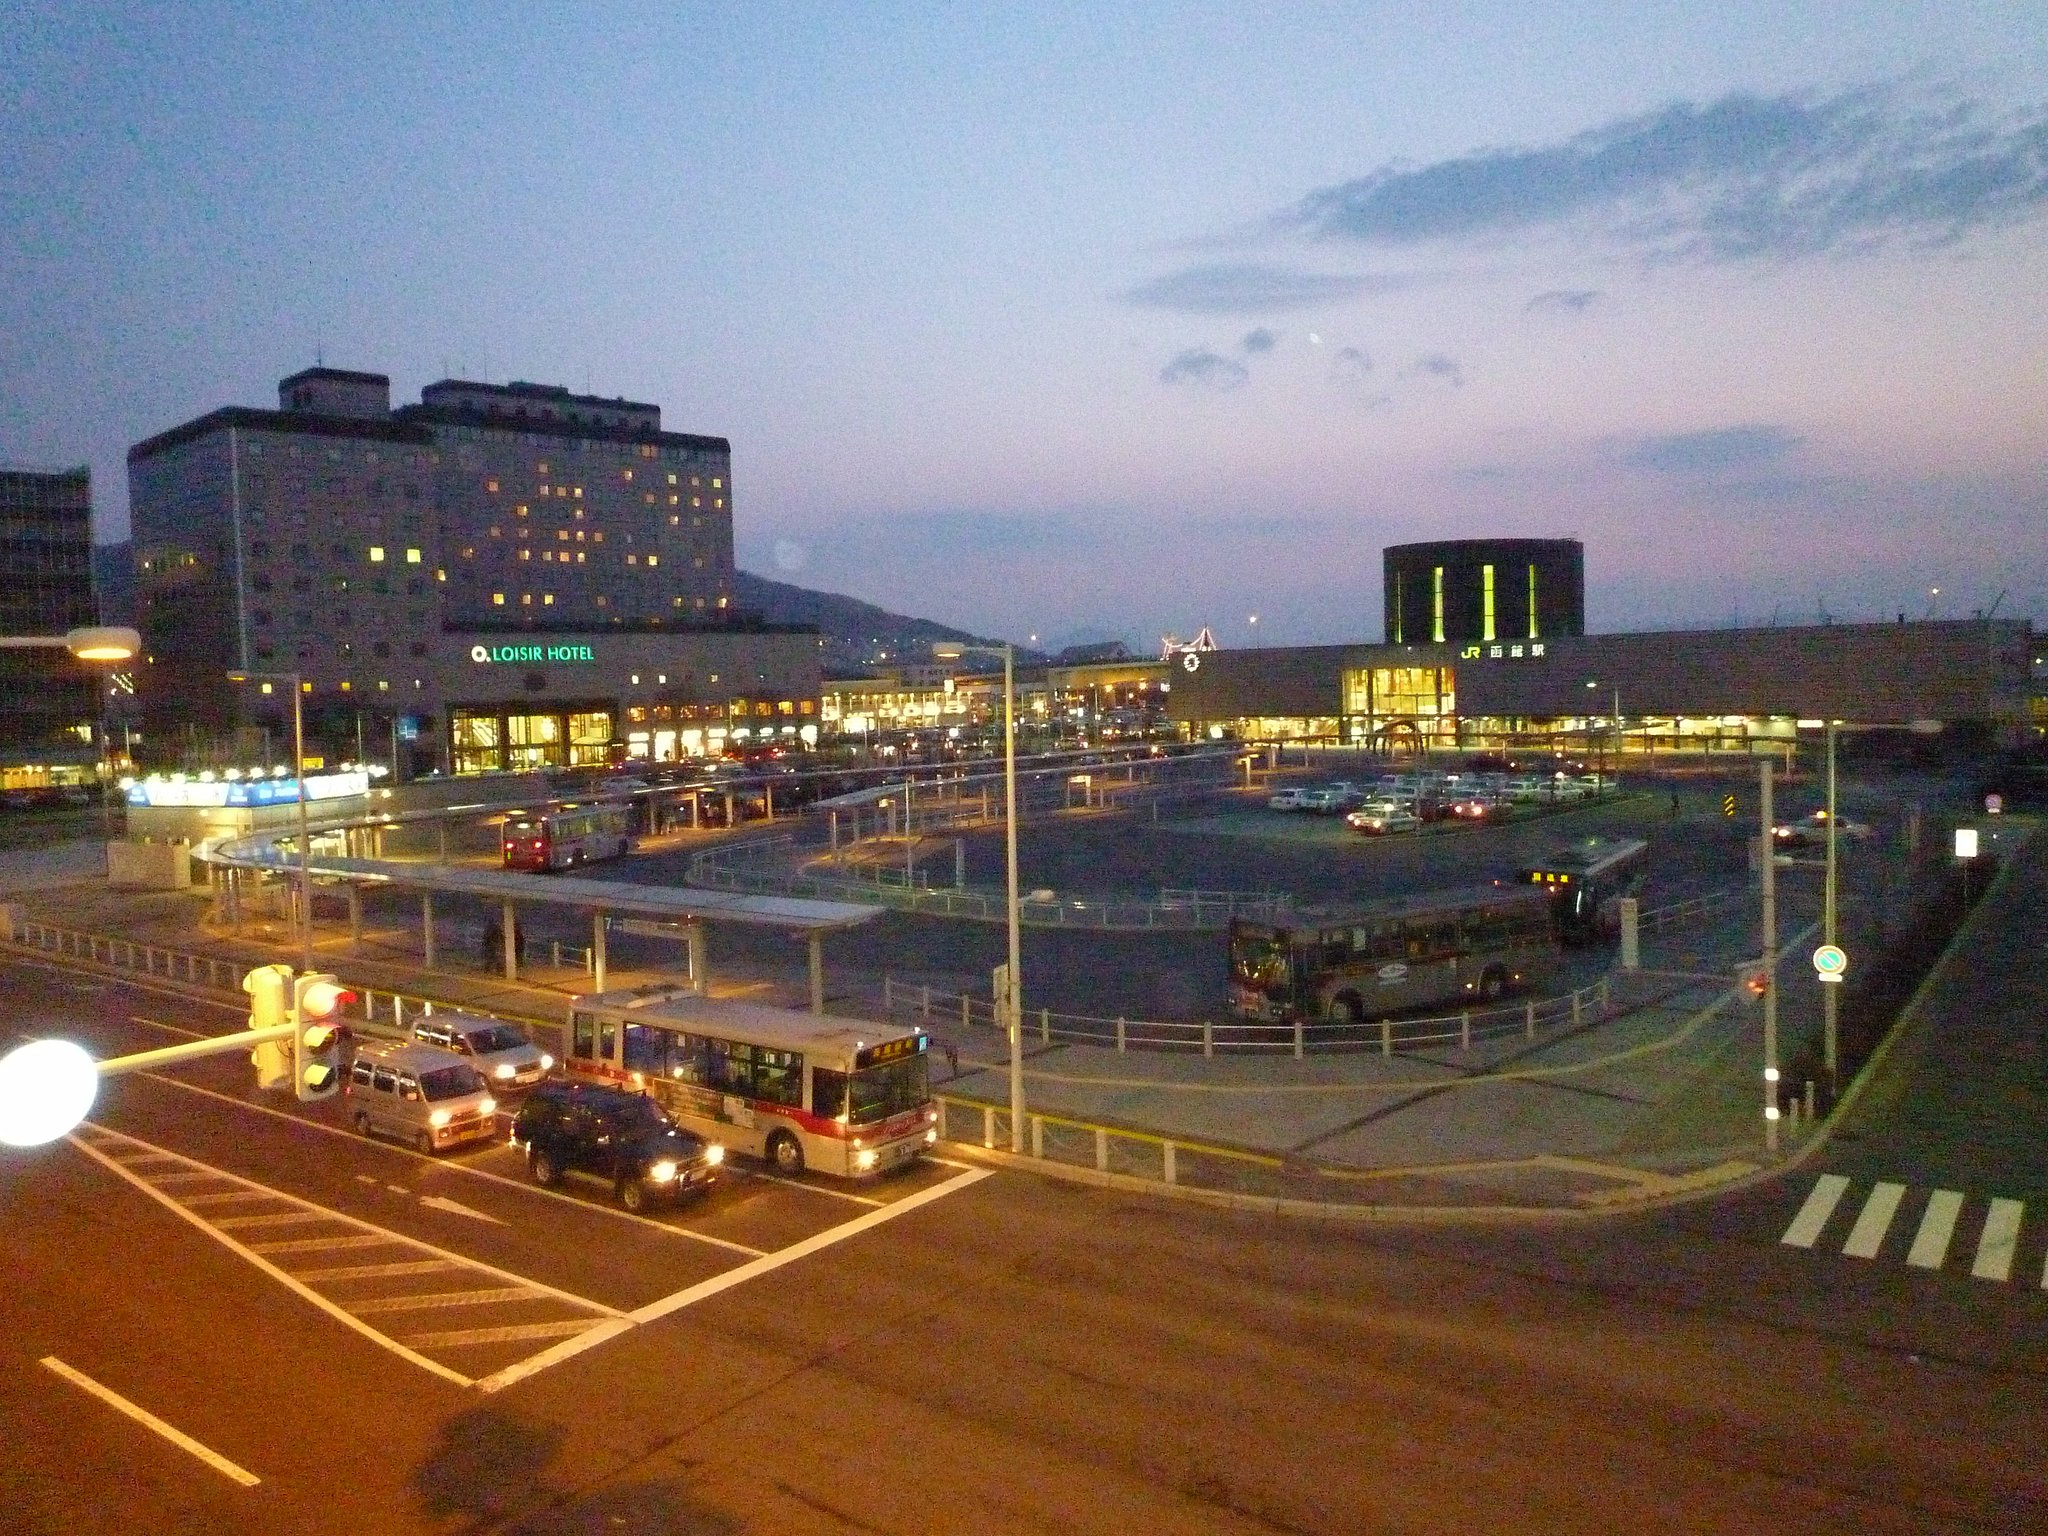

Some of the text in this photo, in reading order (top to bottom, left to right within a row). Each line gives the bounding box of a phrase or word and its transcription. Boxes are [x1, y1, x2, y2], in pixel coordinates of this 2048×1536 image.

[493, 647, 542, 660] LOISIR
[548, 647, 594, 660] HOTEL
[1461, 646, 1481, 659] JR
